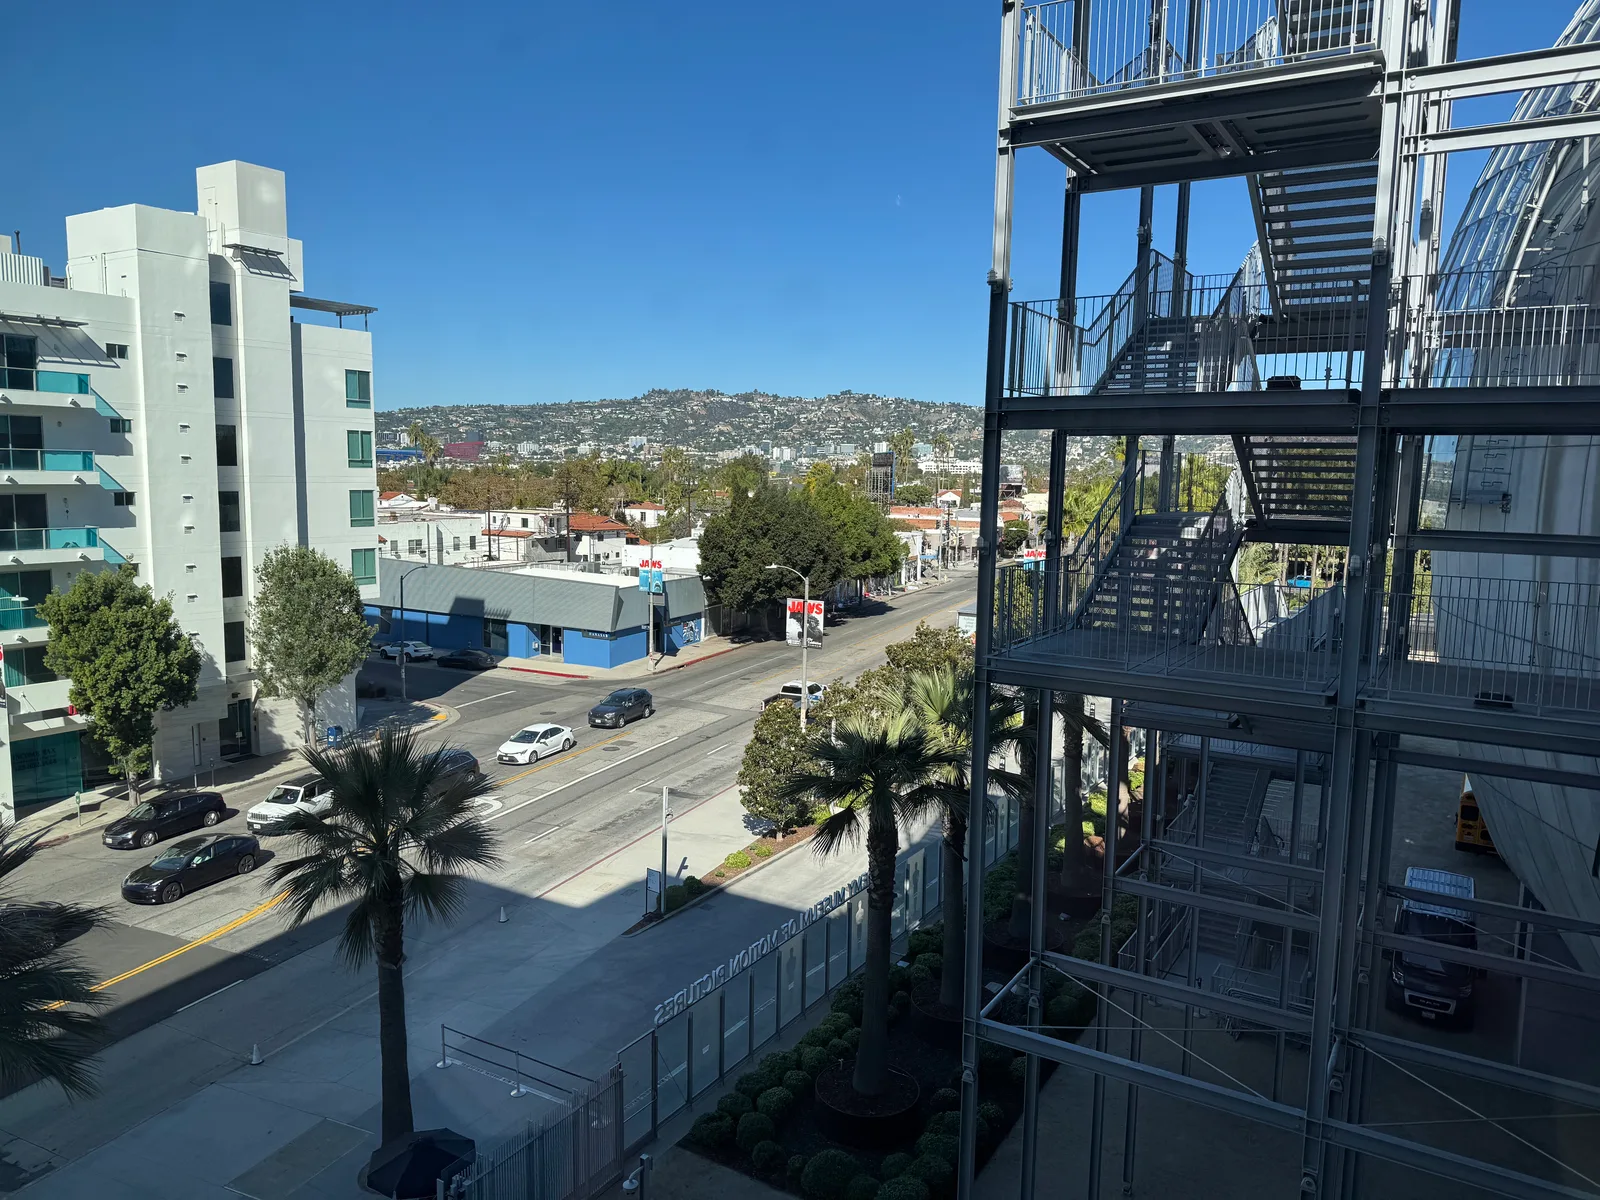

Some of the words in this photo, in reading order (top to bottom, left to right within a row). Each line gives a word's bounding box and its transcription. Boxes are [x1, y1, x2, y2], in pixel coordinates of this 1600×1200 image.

[1024, 550, 1046, 558] JAWS
[639, 559, 662, 569] JAWS
[788, 601, 823, 615] JAWS
